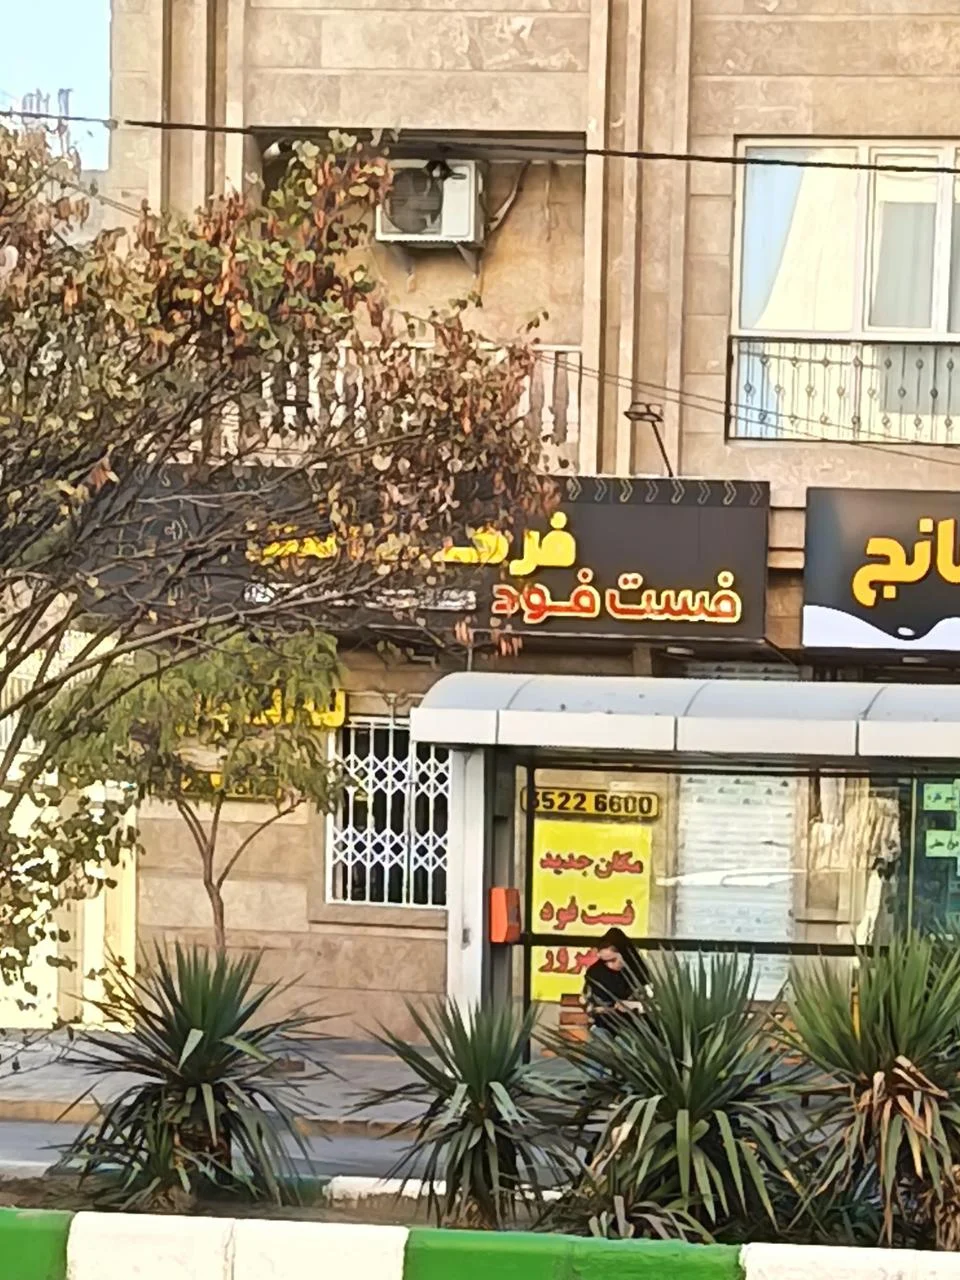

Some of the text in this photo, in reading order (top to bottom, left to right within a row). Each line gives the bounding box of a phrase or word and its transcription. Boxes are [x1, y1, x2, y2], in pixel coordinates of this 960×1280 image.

[491, 567, 600, 624] فود
[605, 570, 742, 623] فست
[594, 793, 654, 815] 6600
[540, 850, 644, 879] مکان جدید
[539, 896, 635, 930] فست فود
